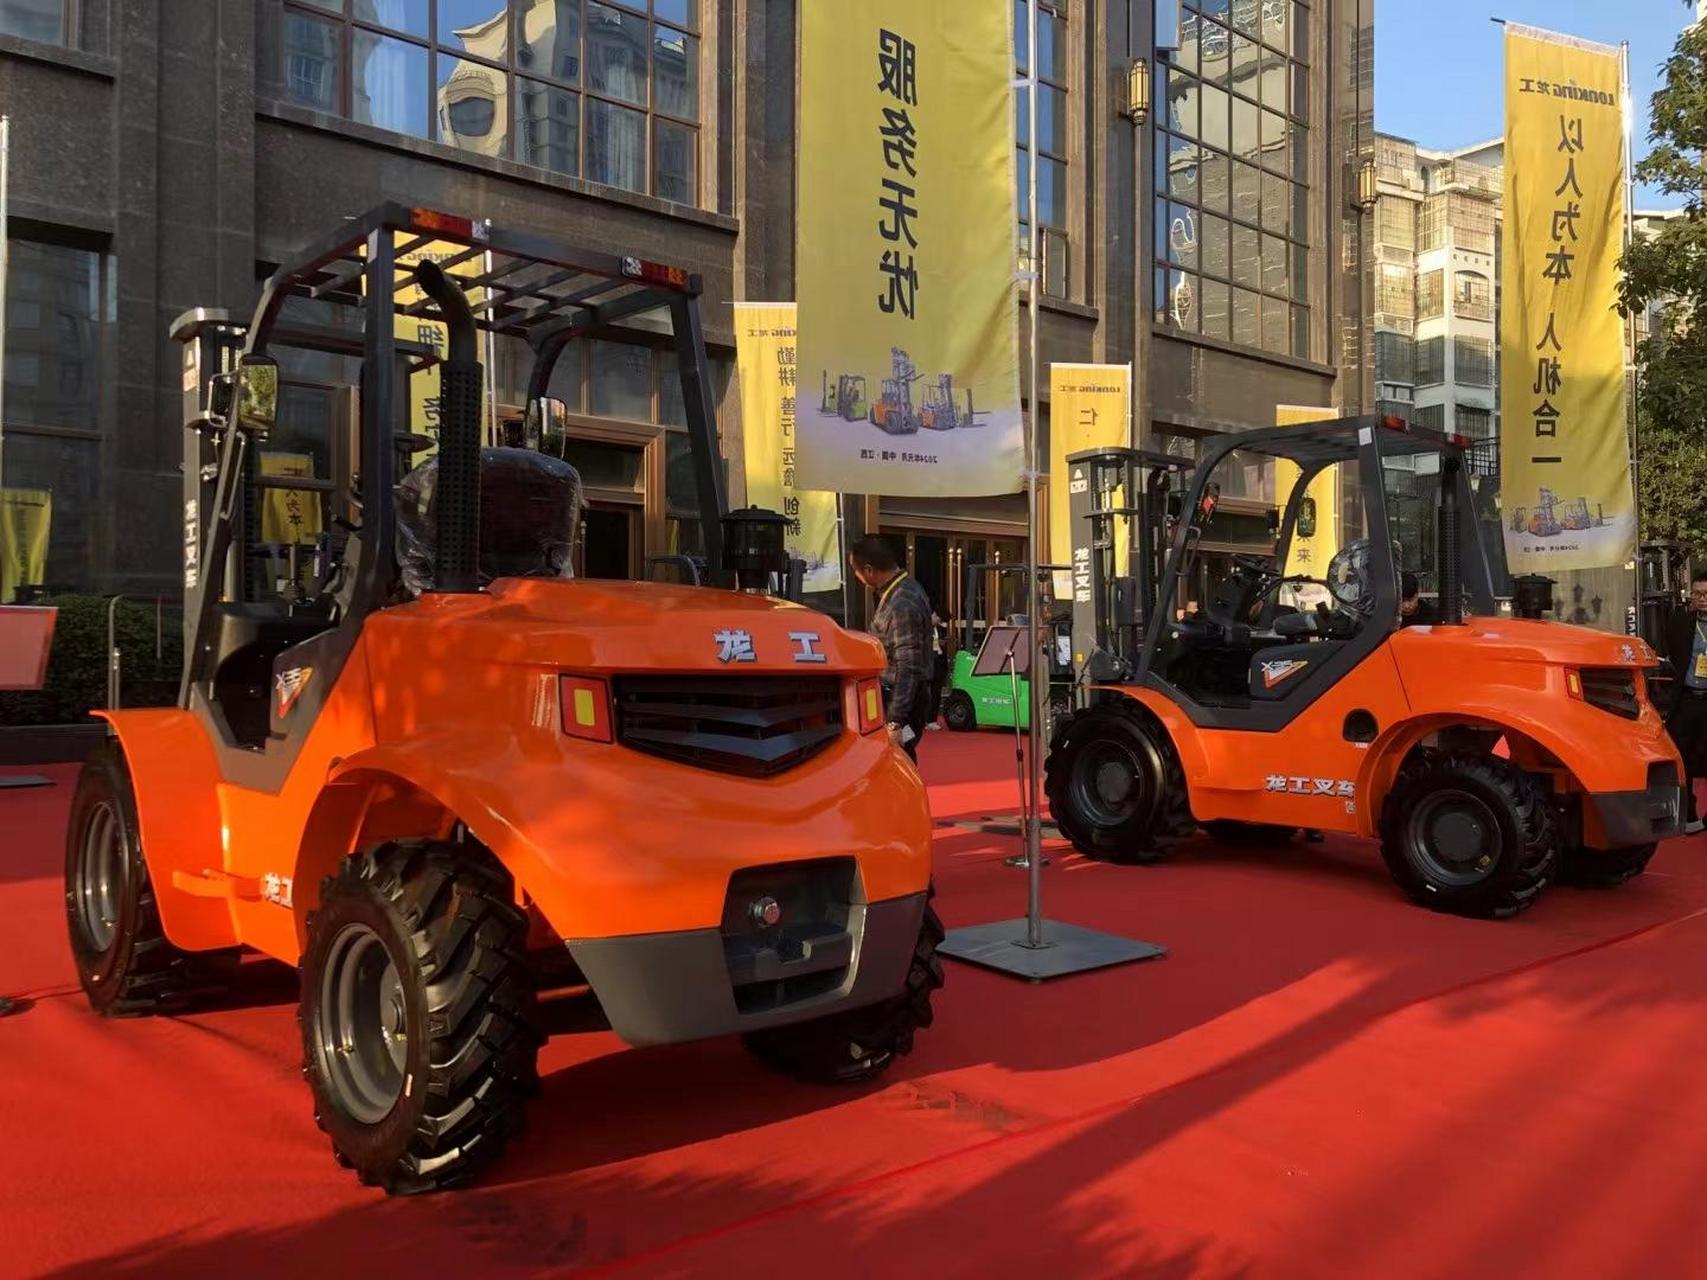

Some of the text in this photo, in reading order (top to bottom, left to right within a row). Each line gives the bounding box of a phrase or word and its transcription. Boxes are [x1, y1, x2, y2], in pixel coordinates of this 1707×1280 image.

[713, 629, 827, 663] 龙工
[1265, 774, 1356, 798] 龙工叉车
